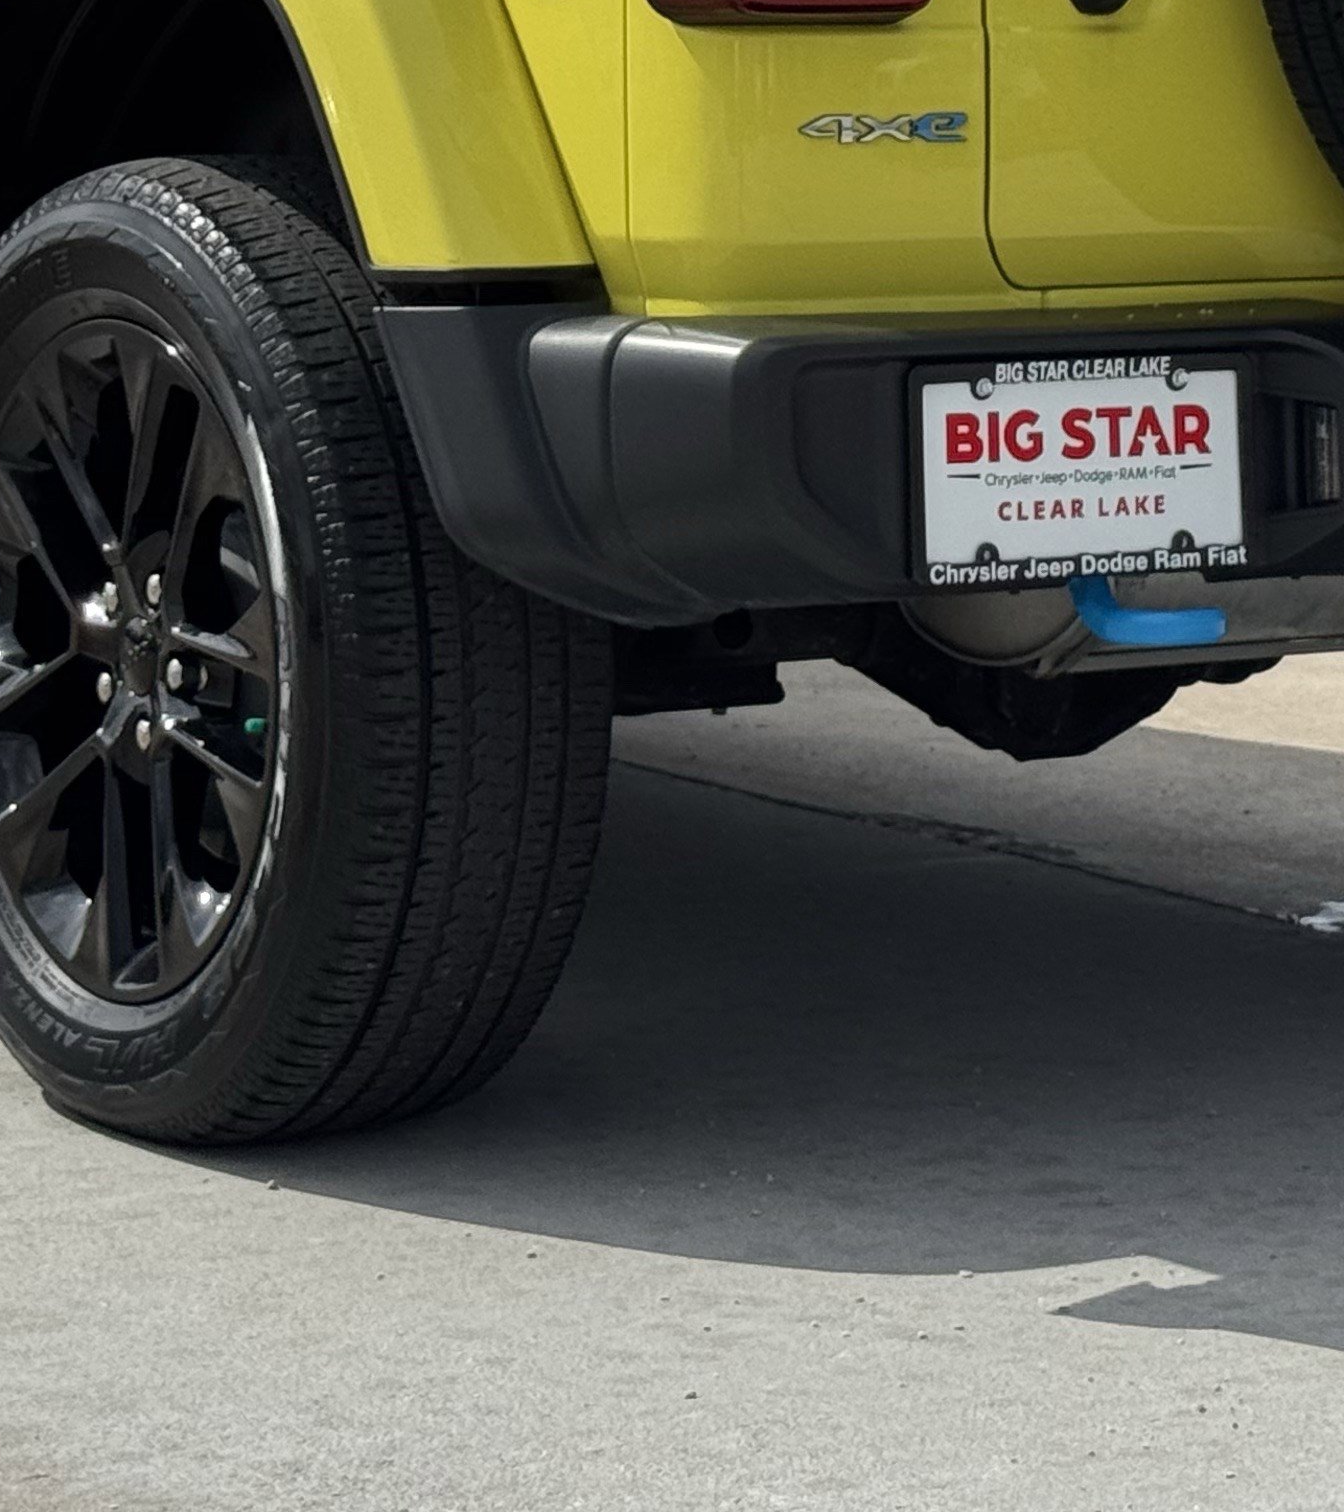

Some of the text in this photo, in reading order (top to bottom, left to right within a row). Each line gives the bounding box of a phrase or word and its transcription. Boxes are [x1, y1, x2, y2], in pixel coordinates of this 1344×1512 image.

[995, 356, 1171, 383] BIG STAR CLEAR LAKE
[945, 404, 1212, 464] BIG STAR
[998, 494, 1166, 521] CLEAR LAKE
[929, 546, 1248, 585] Chrysler Jeep Dodge Ram Fiat
